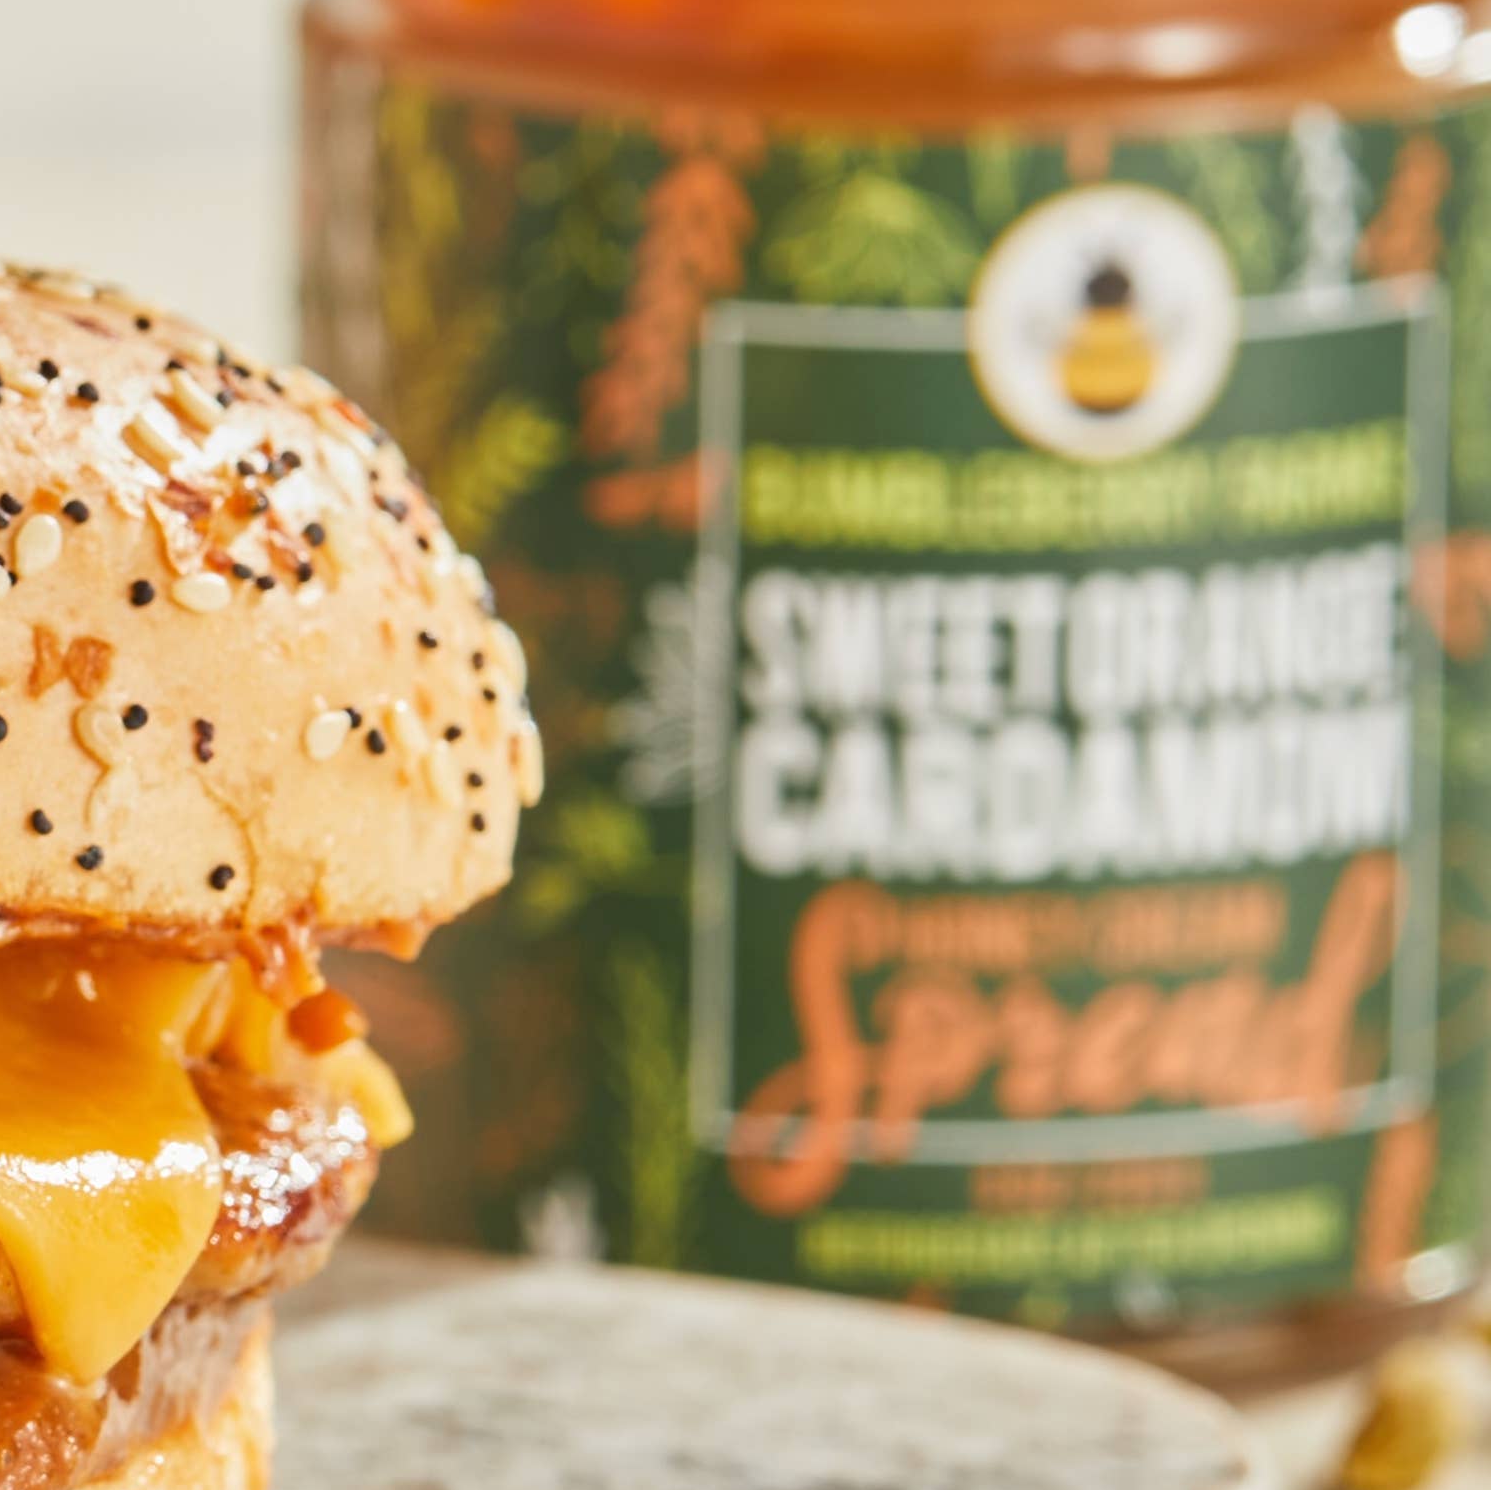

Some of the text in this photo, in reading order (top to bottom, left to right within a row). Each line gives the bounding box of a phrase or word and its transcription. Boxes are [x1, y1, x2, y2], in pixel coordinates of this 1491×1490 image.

[741, 543, 1407, 723] SWEET ORANGE
[737, 703, 1413, 879] CARDAMOM
[727, 847, 1409, 1217] Spread
